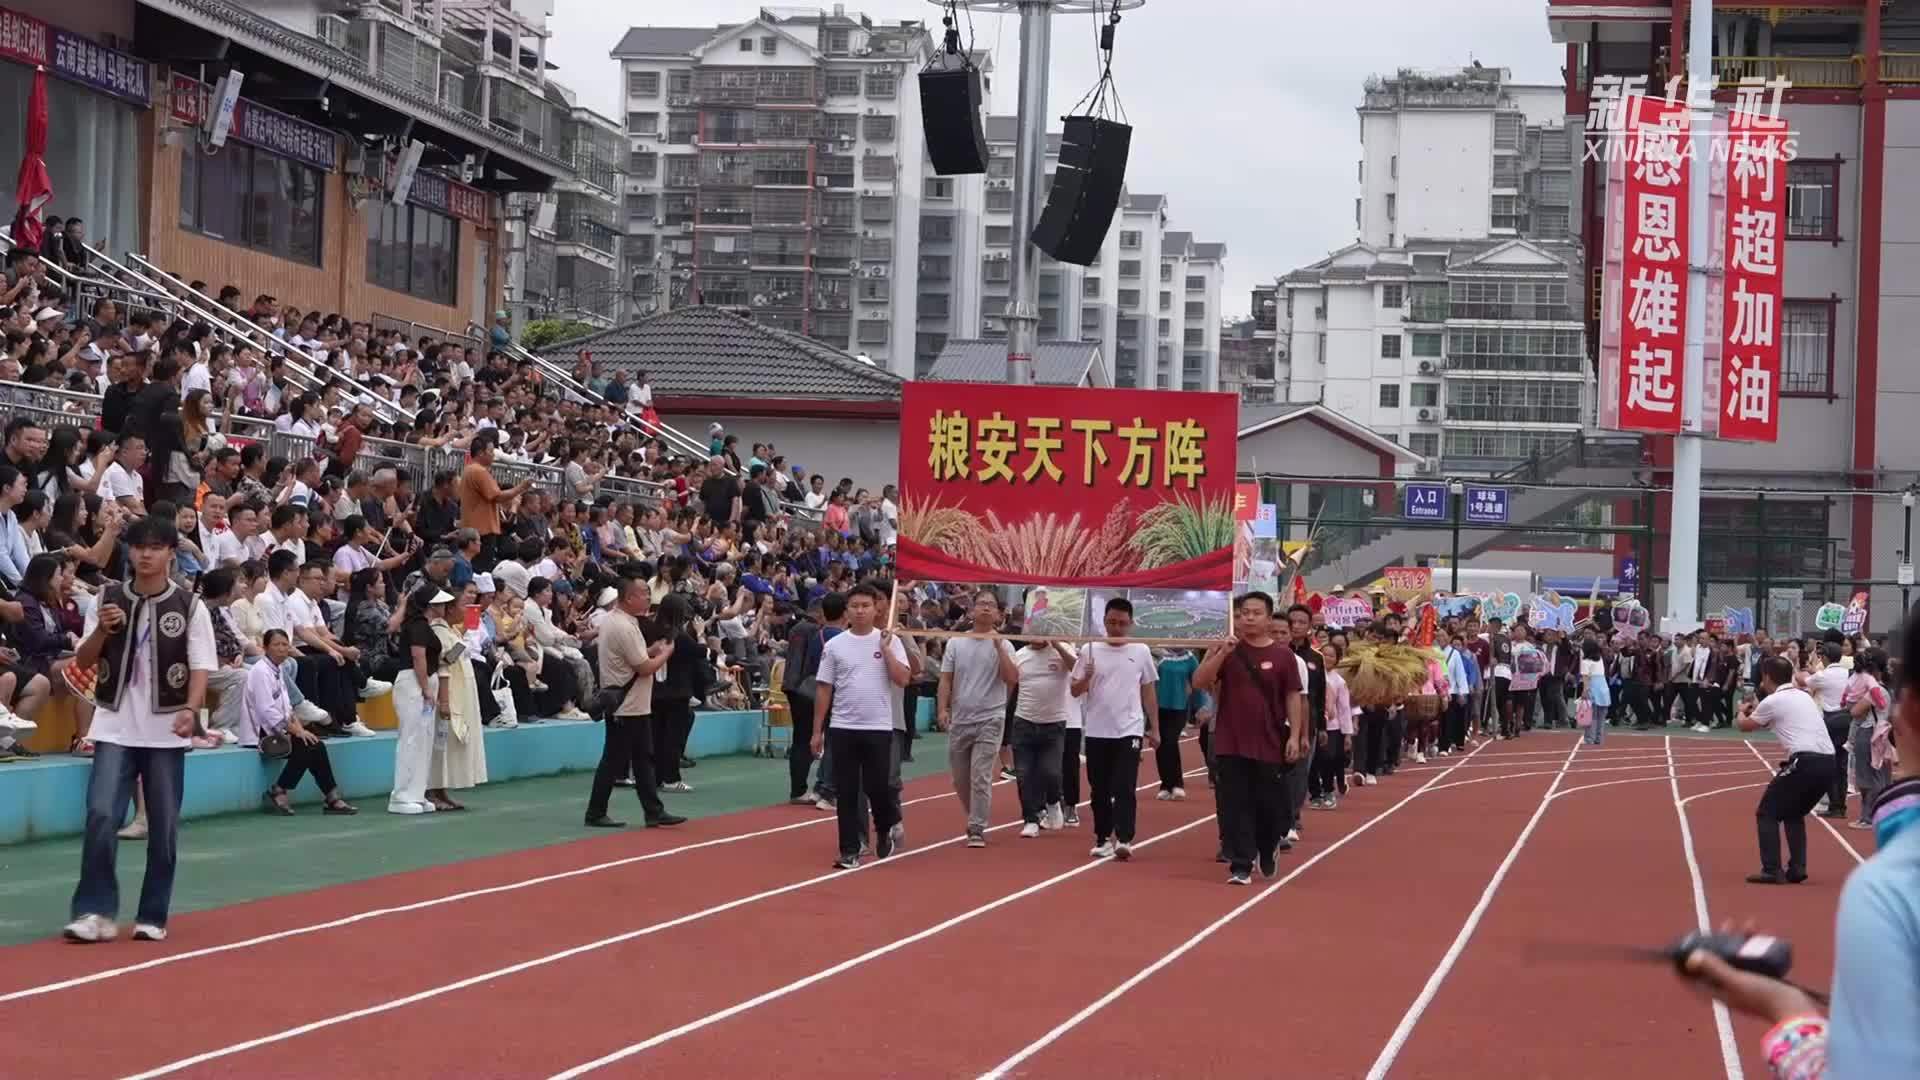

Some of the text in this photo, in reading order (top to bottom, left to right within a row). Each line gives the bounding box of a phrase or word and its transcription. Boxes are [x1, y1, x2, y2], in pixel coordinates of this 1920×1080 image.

[1626, 119, 1681, 413] 感恩雄起
[1726, 131, 1777, 424] 村超加油
[927, 409, 1206, 488] 粮安天下方阵
[1411, 505, 1438, 516] Entrance
[1415, 489, 1437, 504] 入口
